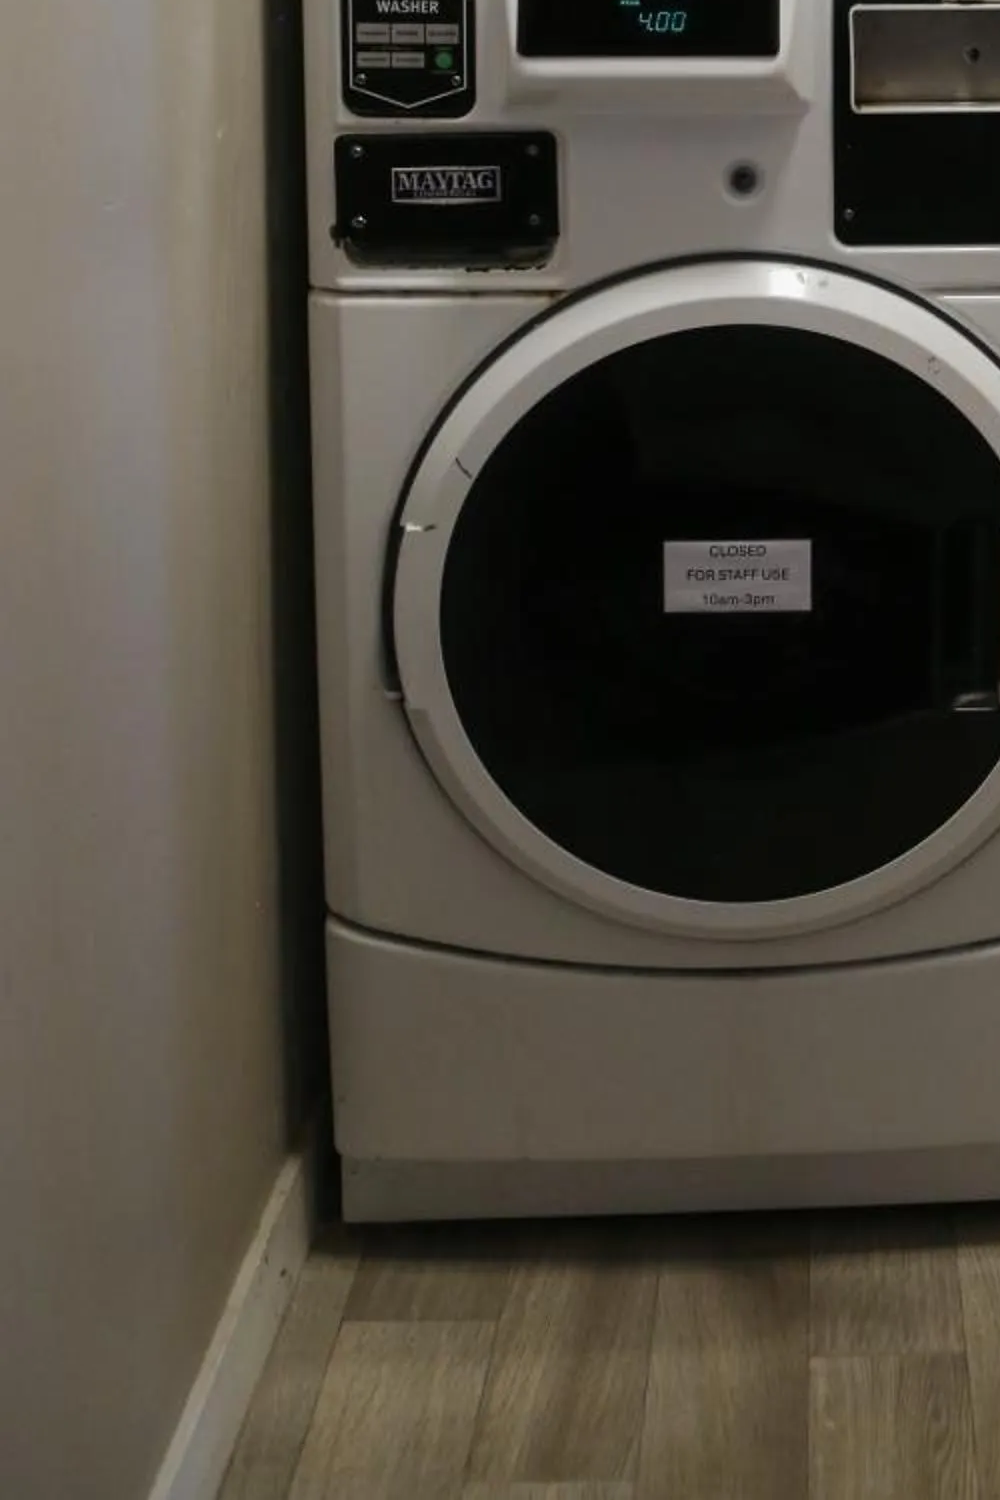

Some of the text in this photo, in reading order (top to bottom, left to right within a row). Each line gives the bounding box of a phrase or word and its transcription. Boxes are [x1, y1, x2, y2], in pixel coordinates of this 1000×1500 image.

[376, 0, 440, 14] WASHER
[639, 11, 687, 33] 4.00
[399, 171, 493, 191] MAYTAG
[709, 544, 767, 558] CLOSED
[686, 568, 790, 581] FOR STAFF USE
[703, 593, 776, 607] 10am-3pm
